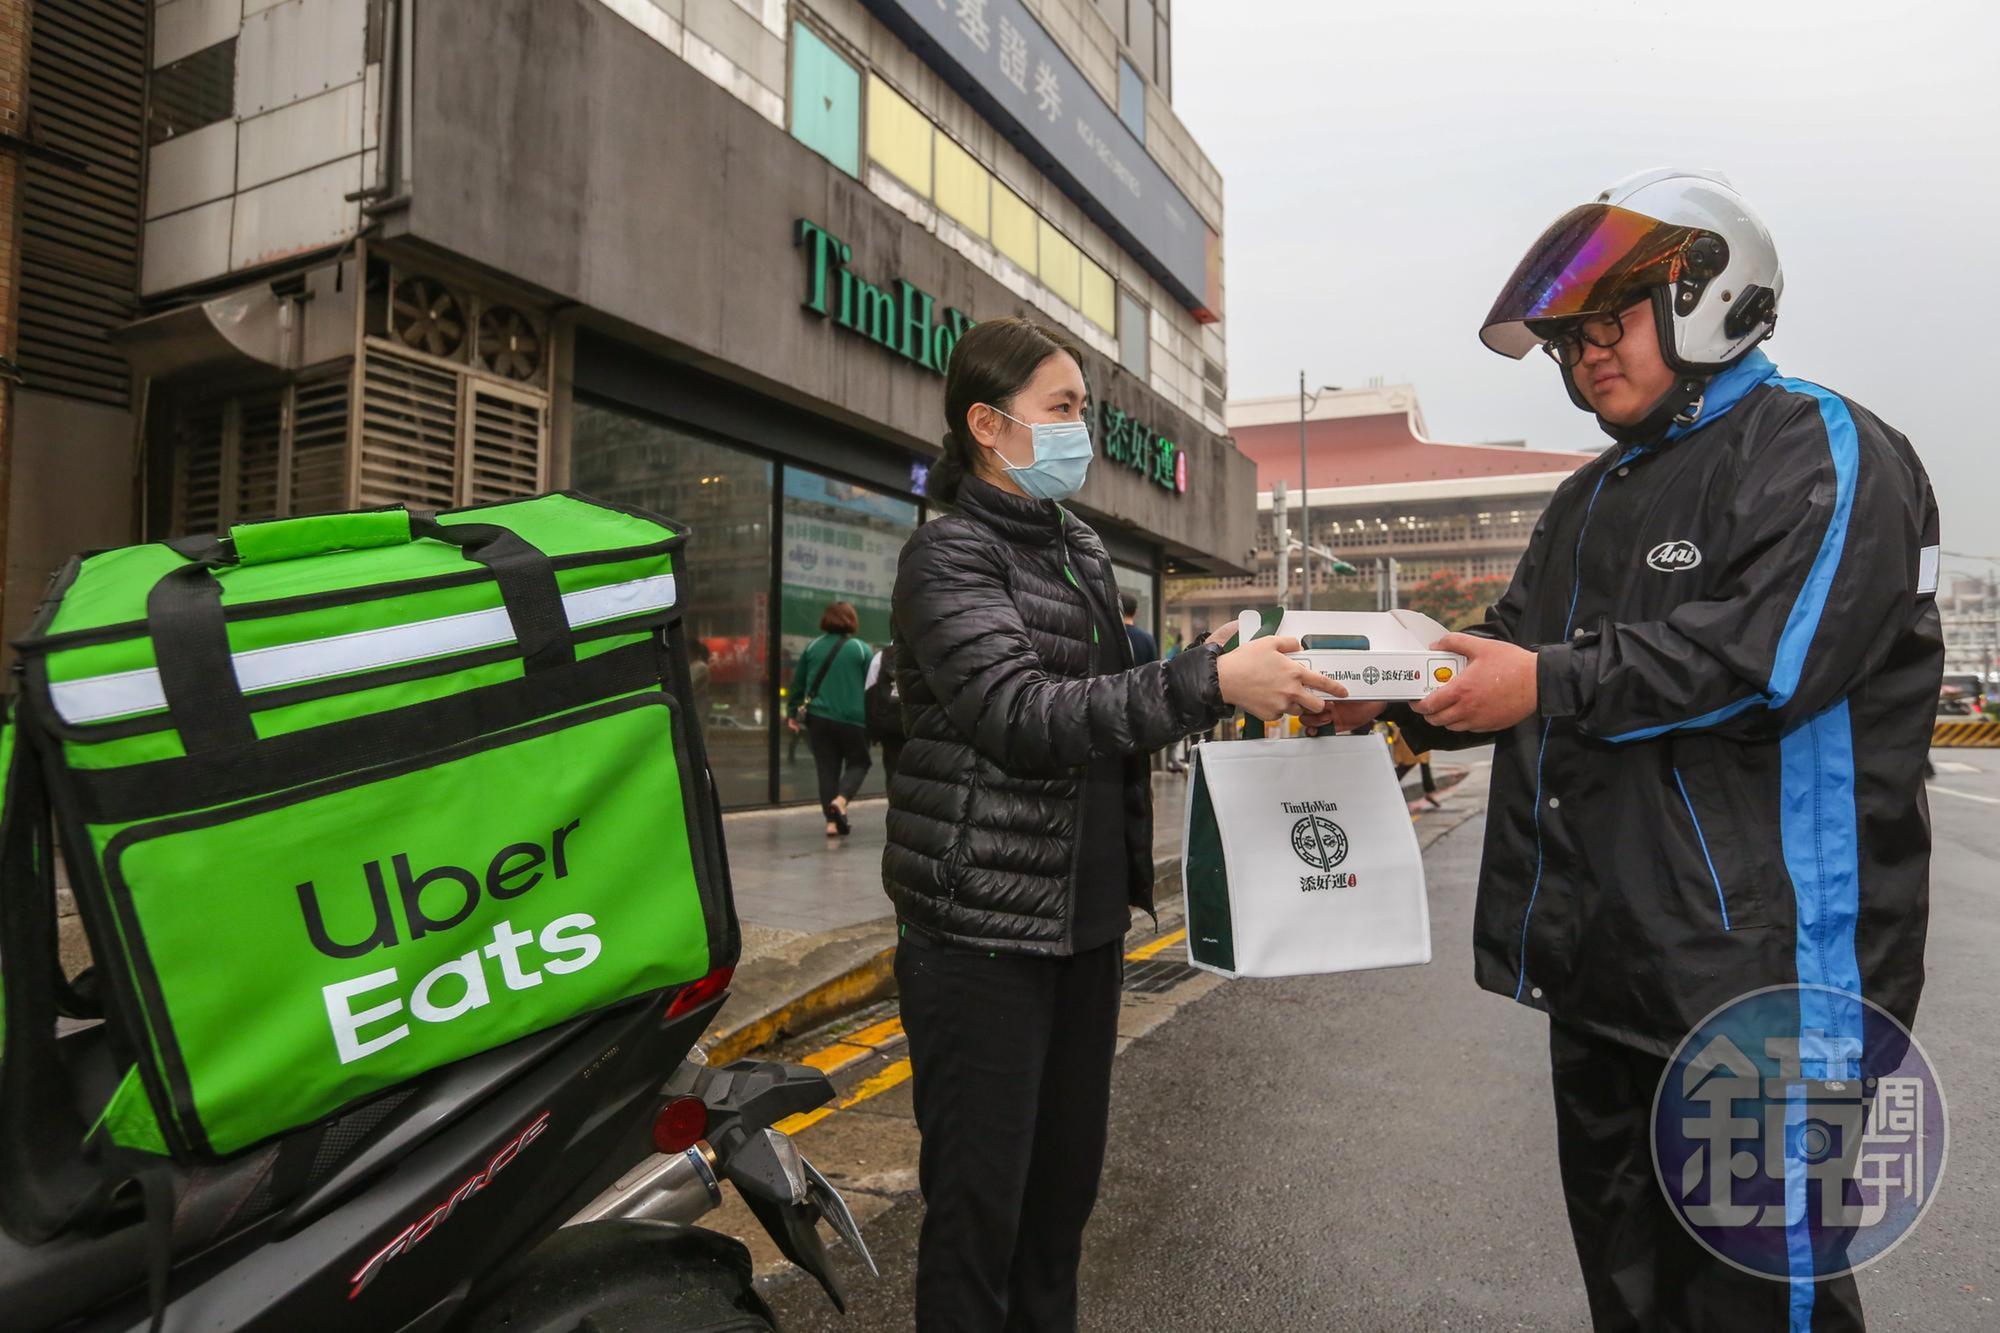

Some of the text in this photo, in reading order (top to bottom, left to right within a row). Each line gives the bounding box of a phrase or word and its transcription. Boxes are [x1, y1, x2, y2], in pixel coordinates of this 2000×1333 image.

[936, 0, 1062, 122] 基證券
[801, 218, 976, 376] TimHo
[1104, 403, 1175, 490] 添好運
[1381, 669, 1414, 681] 添好運
[1281, 800, 1338, 814] TimHoWan
[296, 818, 581, 959] Uber
[1300, 872, 1348, 892] 添好運
[322, 912, 602, 1065] Eats
